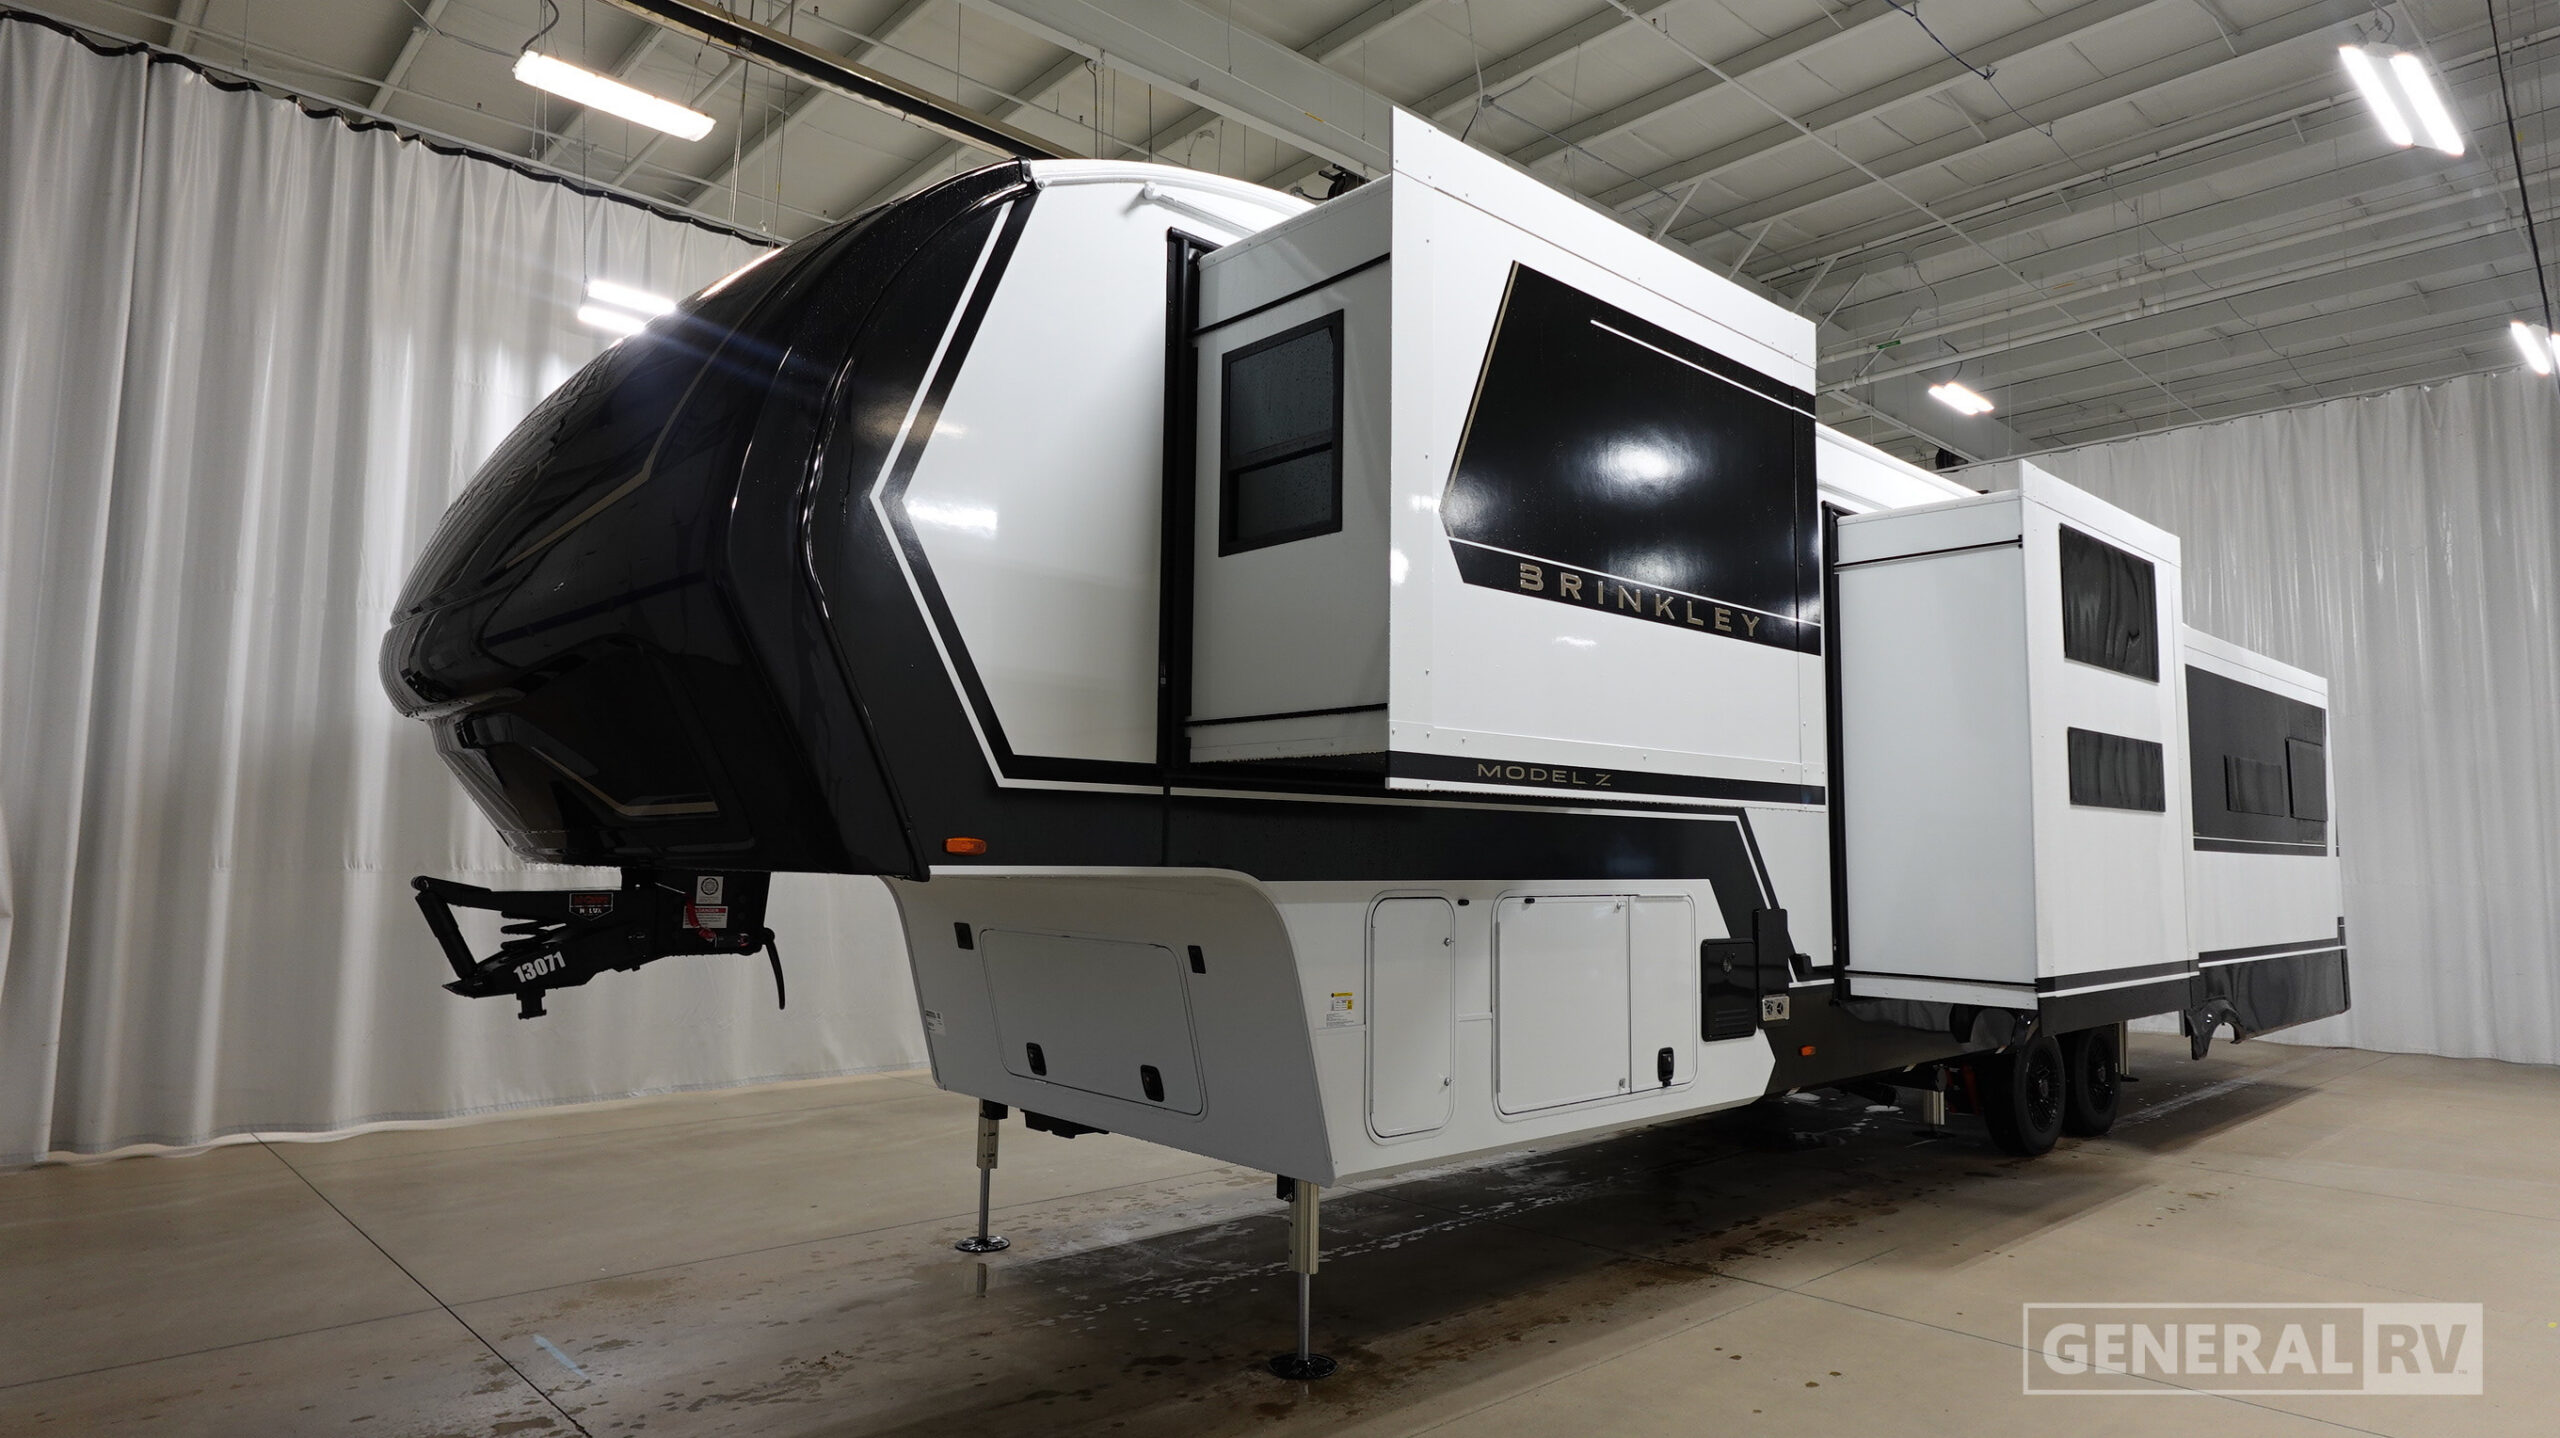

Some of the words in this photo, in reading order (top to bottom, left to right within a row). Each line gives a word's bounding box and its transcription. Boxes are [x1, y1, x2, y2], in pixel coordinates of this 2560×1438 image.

[1519, 562, 1760, 637] BRINKLEY
[1477, 763, 1588, 784] MODEL
[1595, 773, 1611, 786] Z
[513, 951, 566, 983] 13071
